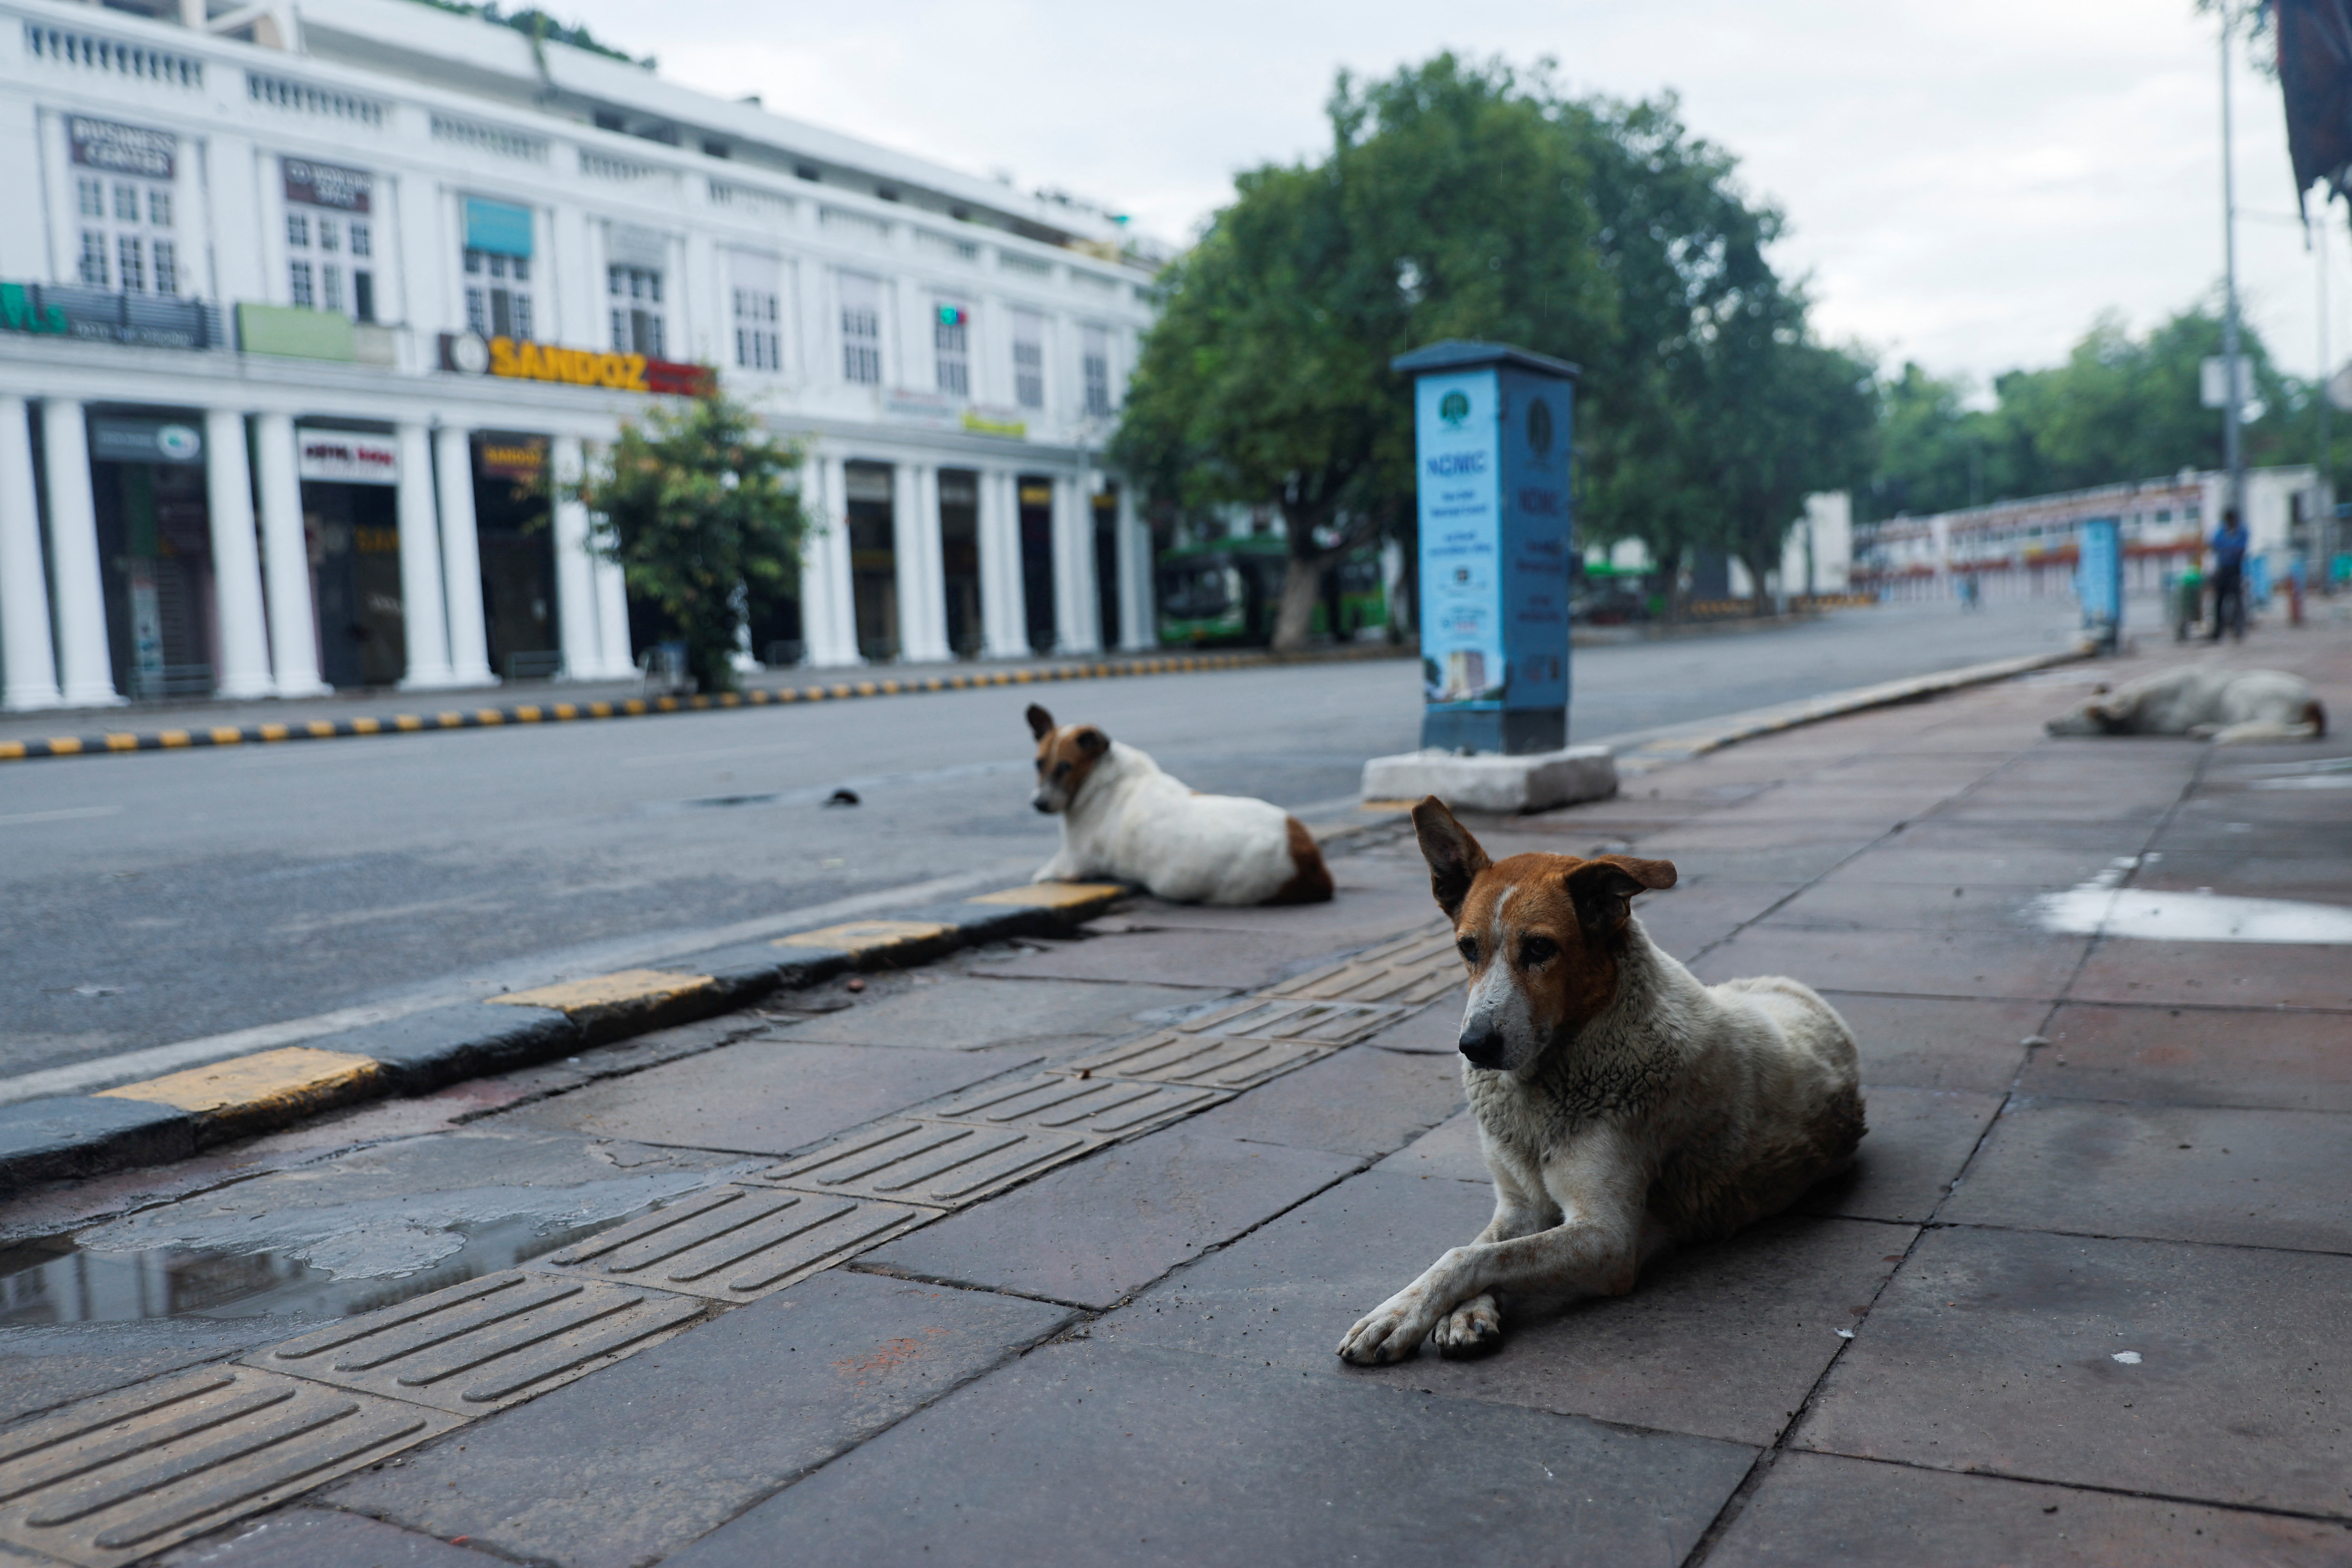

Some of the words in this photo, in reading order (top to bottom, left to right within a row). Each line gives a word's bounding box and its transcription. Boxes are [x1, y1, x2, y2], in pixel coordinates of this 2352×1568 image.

[73, 118, 175, 151] BUSINESS
[86, 141, 168, 174] CENTER
[489, 334, 650, 393] SANDOZ
